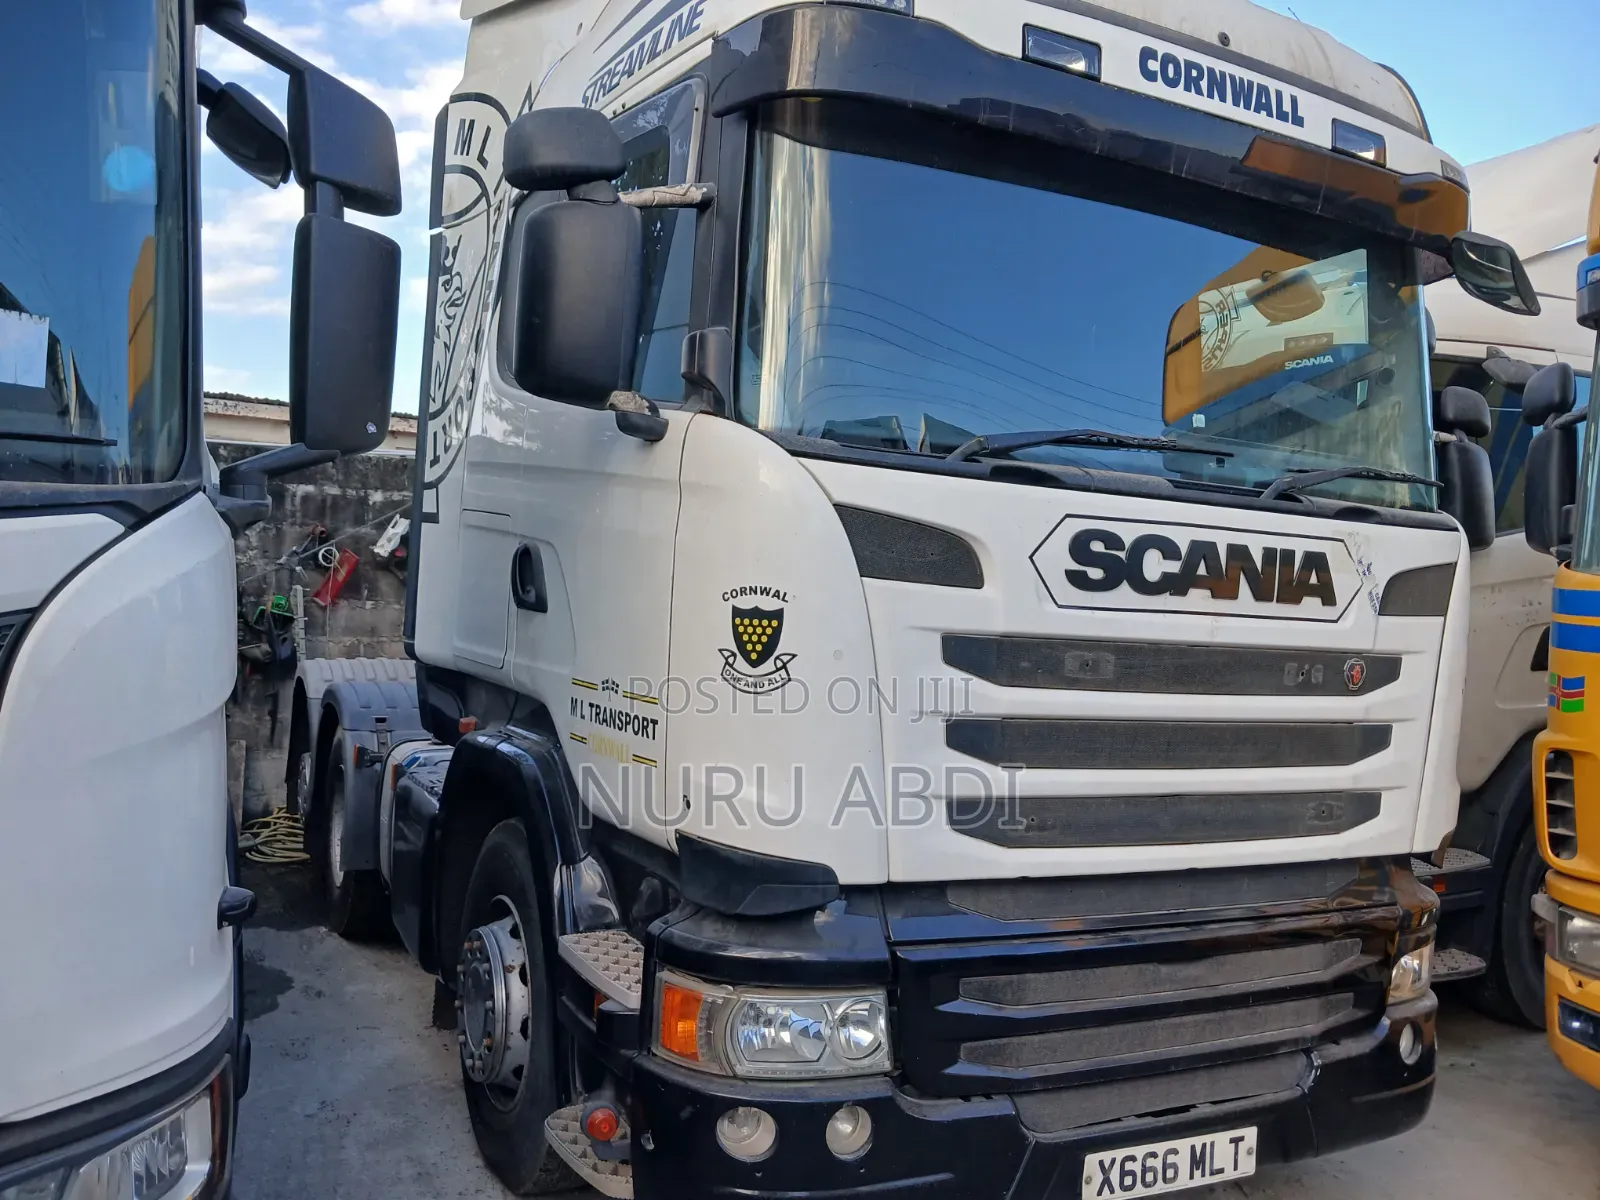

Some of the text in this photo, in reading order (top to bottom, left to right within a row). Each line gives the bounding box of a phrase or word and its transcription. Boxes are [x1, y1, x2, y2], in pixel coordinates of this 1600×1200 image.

[581, 5, 705, 107] STREAMLINE
[1138, 46, 1305, 129] CORNWALL
[1284, 354, 1334, 371] SCANIA
[1064, 527, 1338, 608] SCANIA
[721, 585, 789, 604] CORNWAL
[724, 668, 787, 689] ONE AND ALL
[588, 701, 659, 741] TRANSPORT
[1096, 1135, 1246, 1197] X666 MLT
